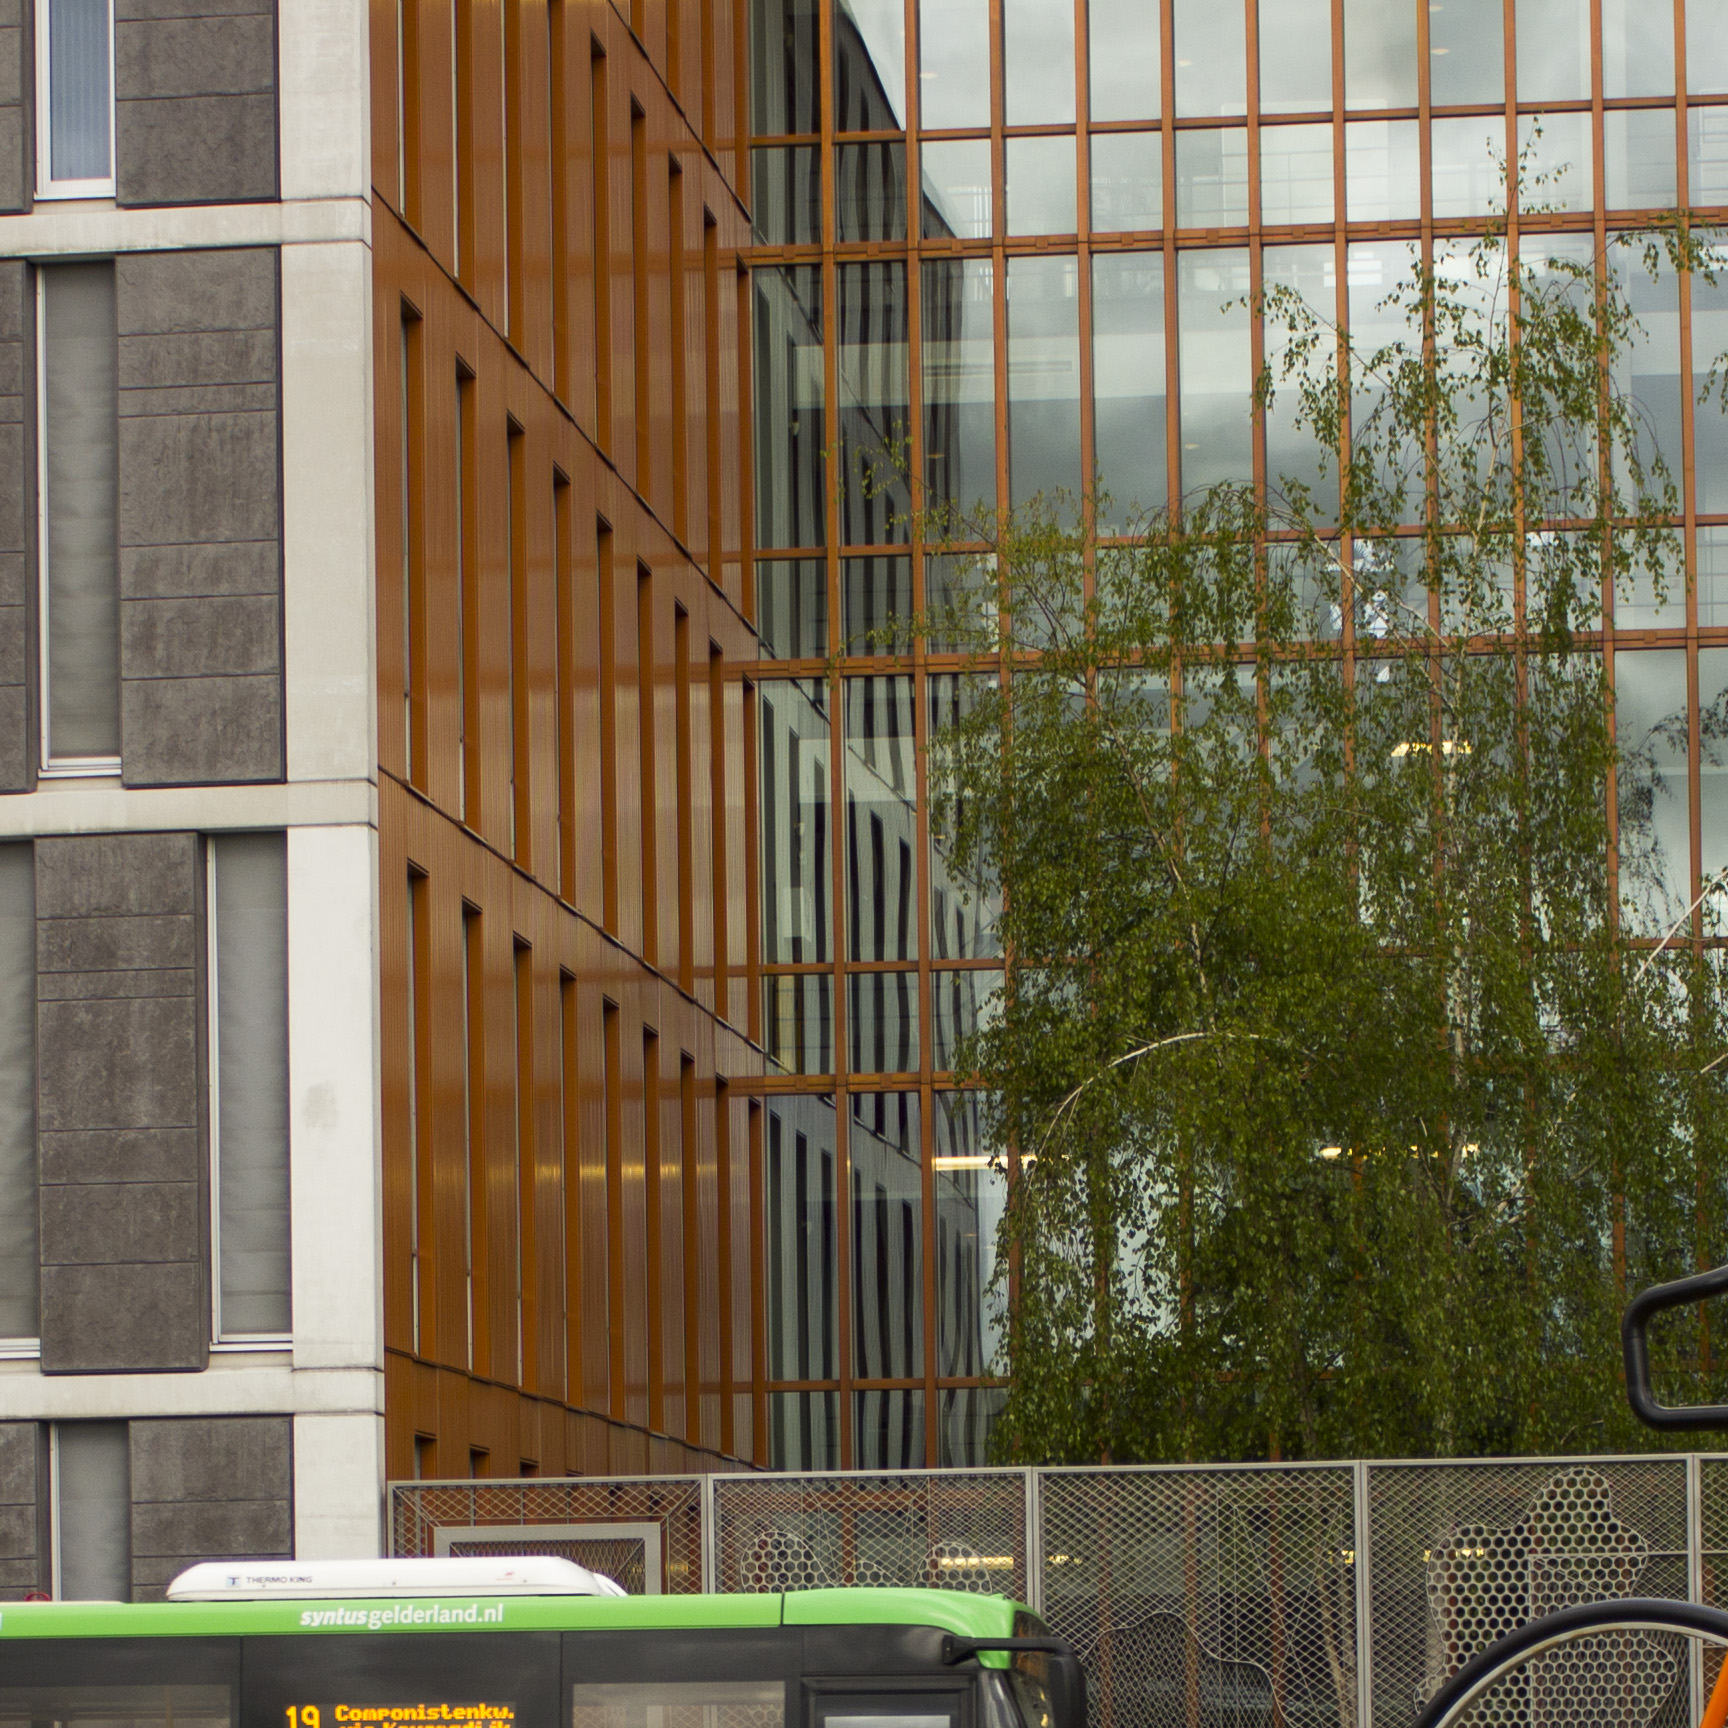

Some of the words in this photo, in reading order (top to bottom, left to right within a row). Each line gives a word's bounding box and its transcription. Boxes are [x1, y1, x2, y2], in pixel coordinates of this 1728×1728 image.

[246, 1576, 288, 1584] THERMO
[290, 1576, 313, 1584] KING
[300, 1603, 503, 1629] syntusgelderland.nl
[334, 1703, 515, 1721] Componistenkw.
